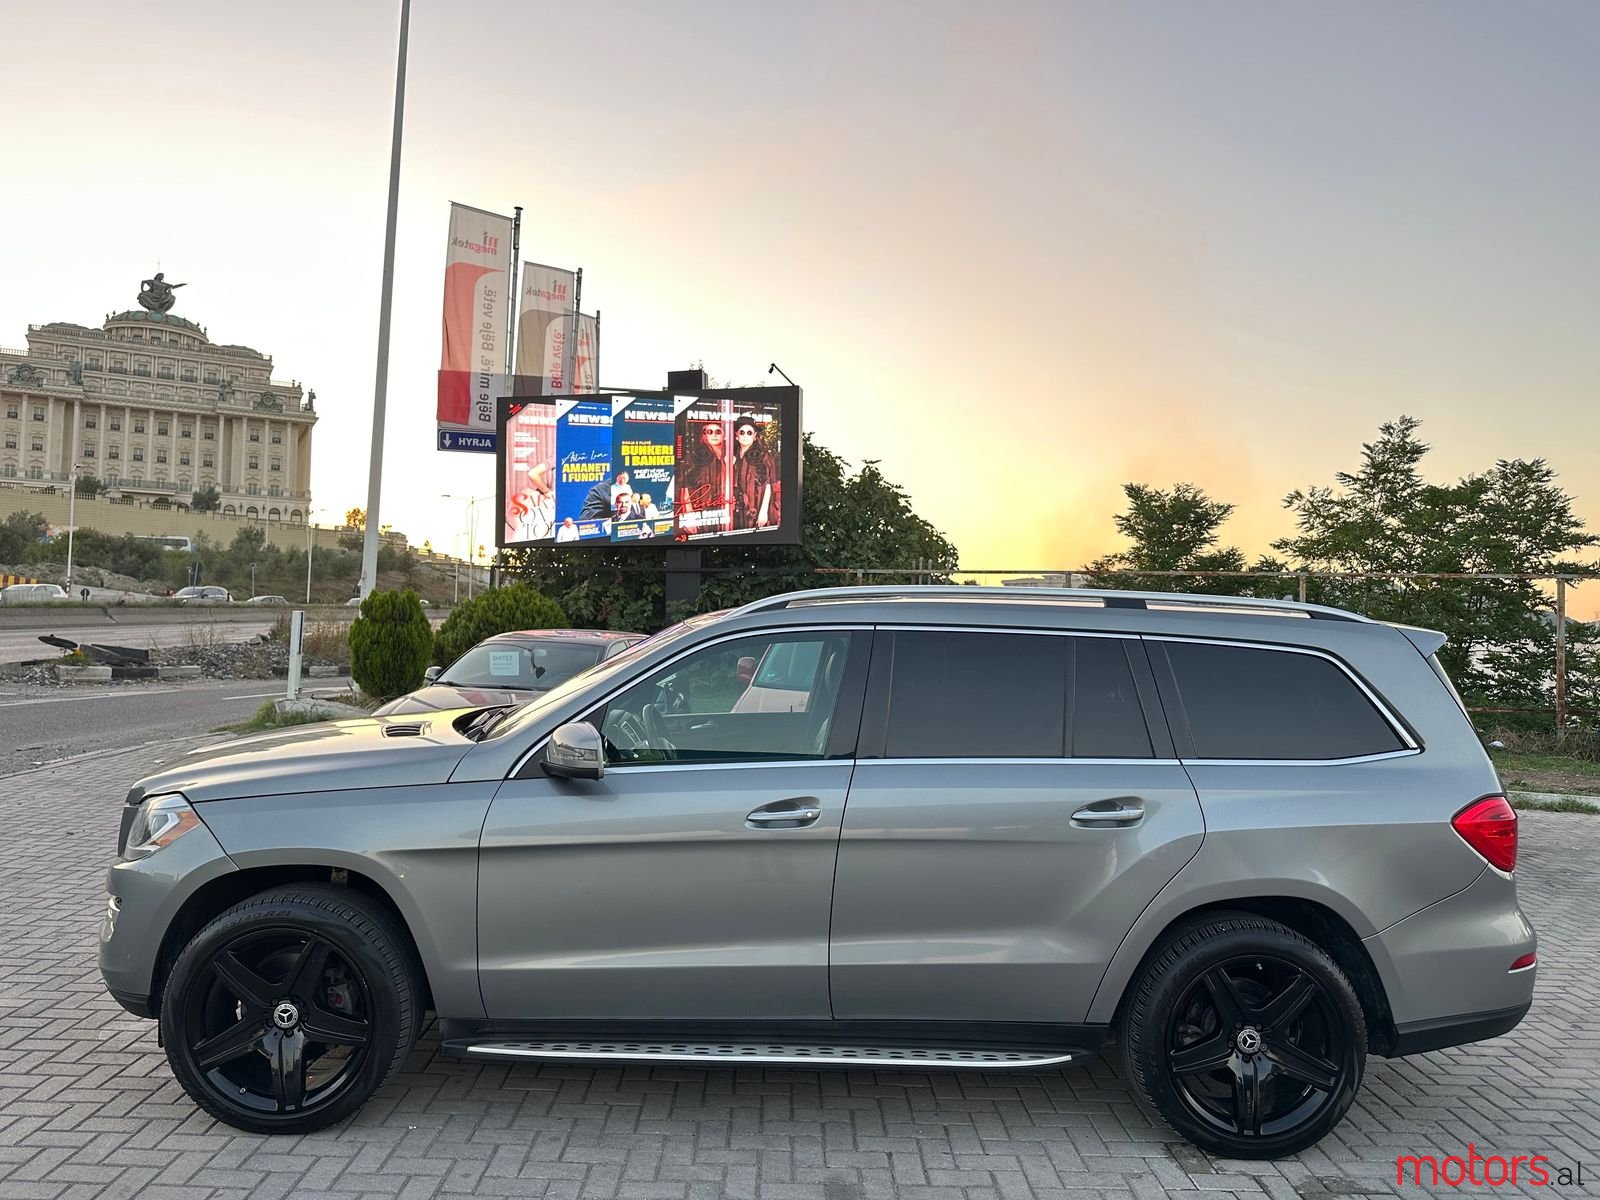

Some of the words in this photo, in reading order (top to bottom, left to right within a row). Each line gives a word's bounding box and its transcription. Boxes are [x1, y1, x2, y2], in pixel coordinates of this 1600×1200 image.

[458, 437, 492, 447] HYRJA
[621, 445, 673, 456] BUNKERI
[562, 463, 610, 473] AMANETI
[568, 473, 605, 483] FUNDIT
